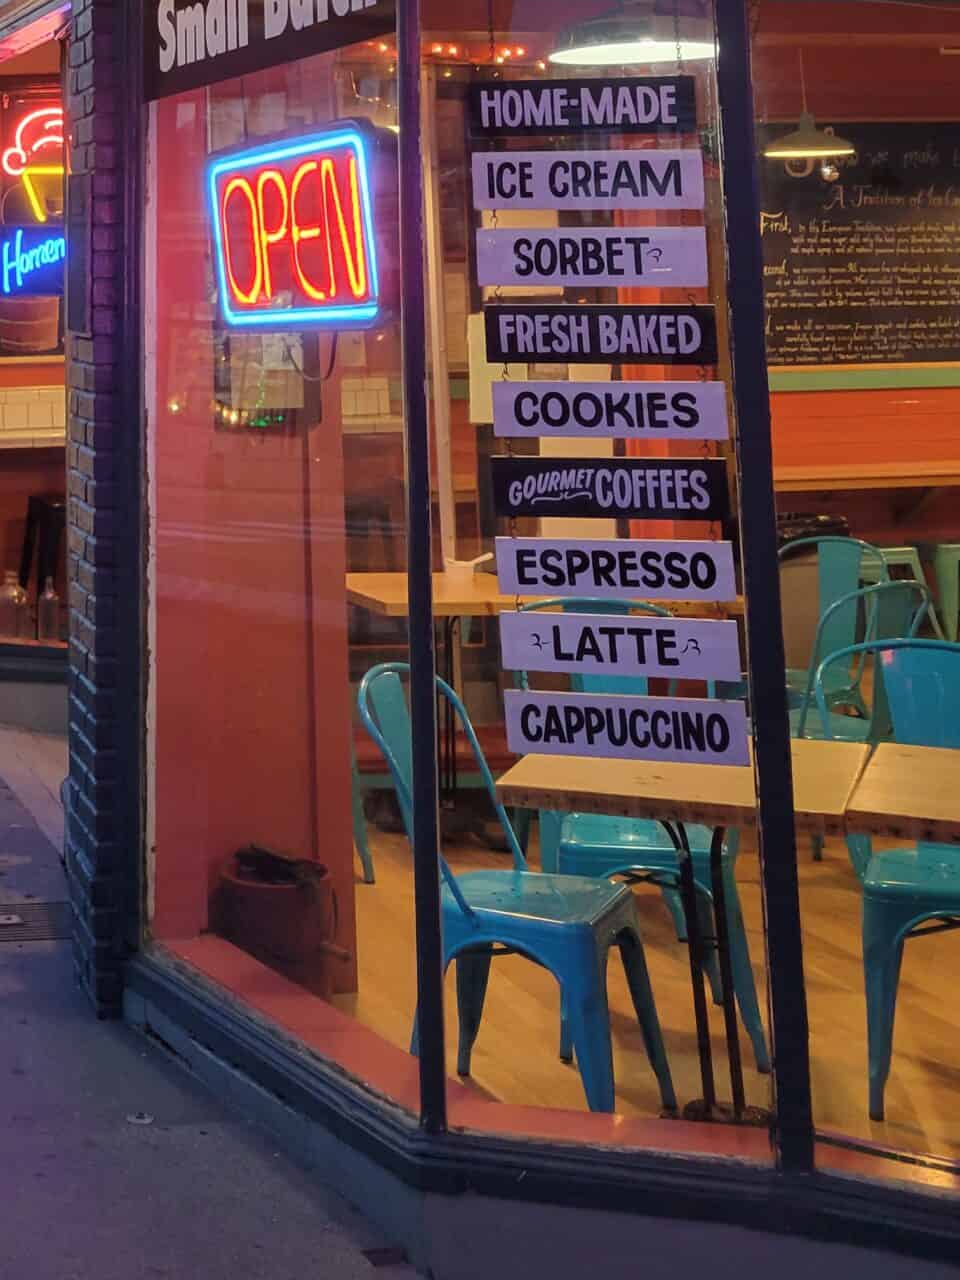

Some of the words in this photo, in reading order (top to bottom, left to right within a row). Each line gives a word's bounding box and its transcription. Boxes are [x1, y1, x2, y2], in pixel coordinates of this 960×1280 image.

[480, 86, 677, 128] HOME-MADE
[487, 161, 533, 199] ICE
[548, 160, 682, 198] CREAM
[222, 157, 366, 304] OPEN
[512, 237, 650, 276] SORBET
[498, 313, 590, 353] FRESH
[598, 314, 702, 354] BAKED
[513, 391, 700, 428] COOKIES
[509, 468, 595, 506] GOURMET
[595, 469, 711, 510] COFFEES
[516, 549, 717, 590] ESPRESSO
[552, 625, 680, 666] LATTE
[520, 703, 730, 753] CAPPUCCINO
